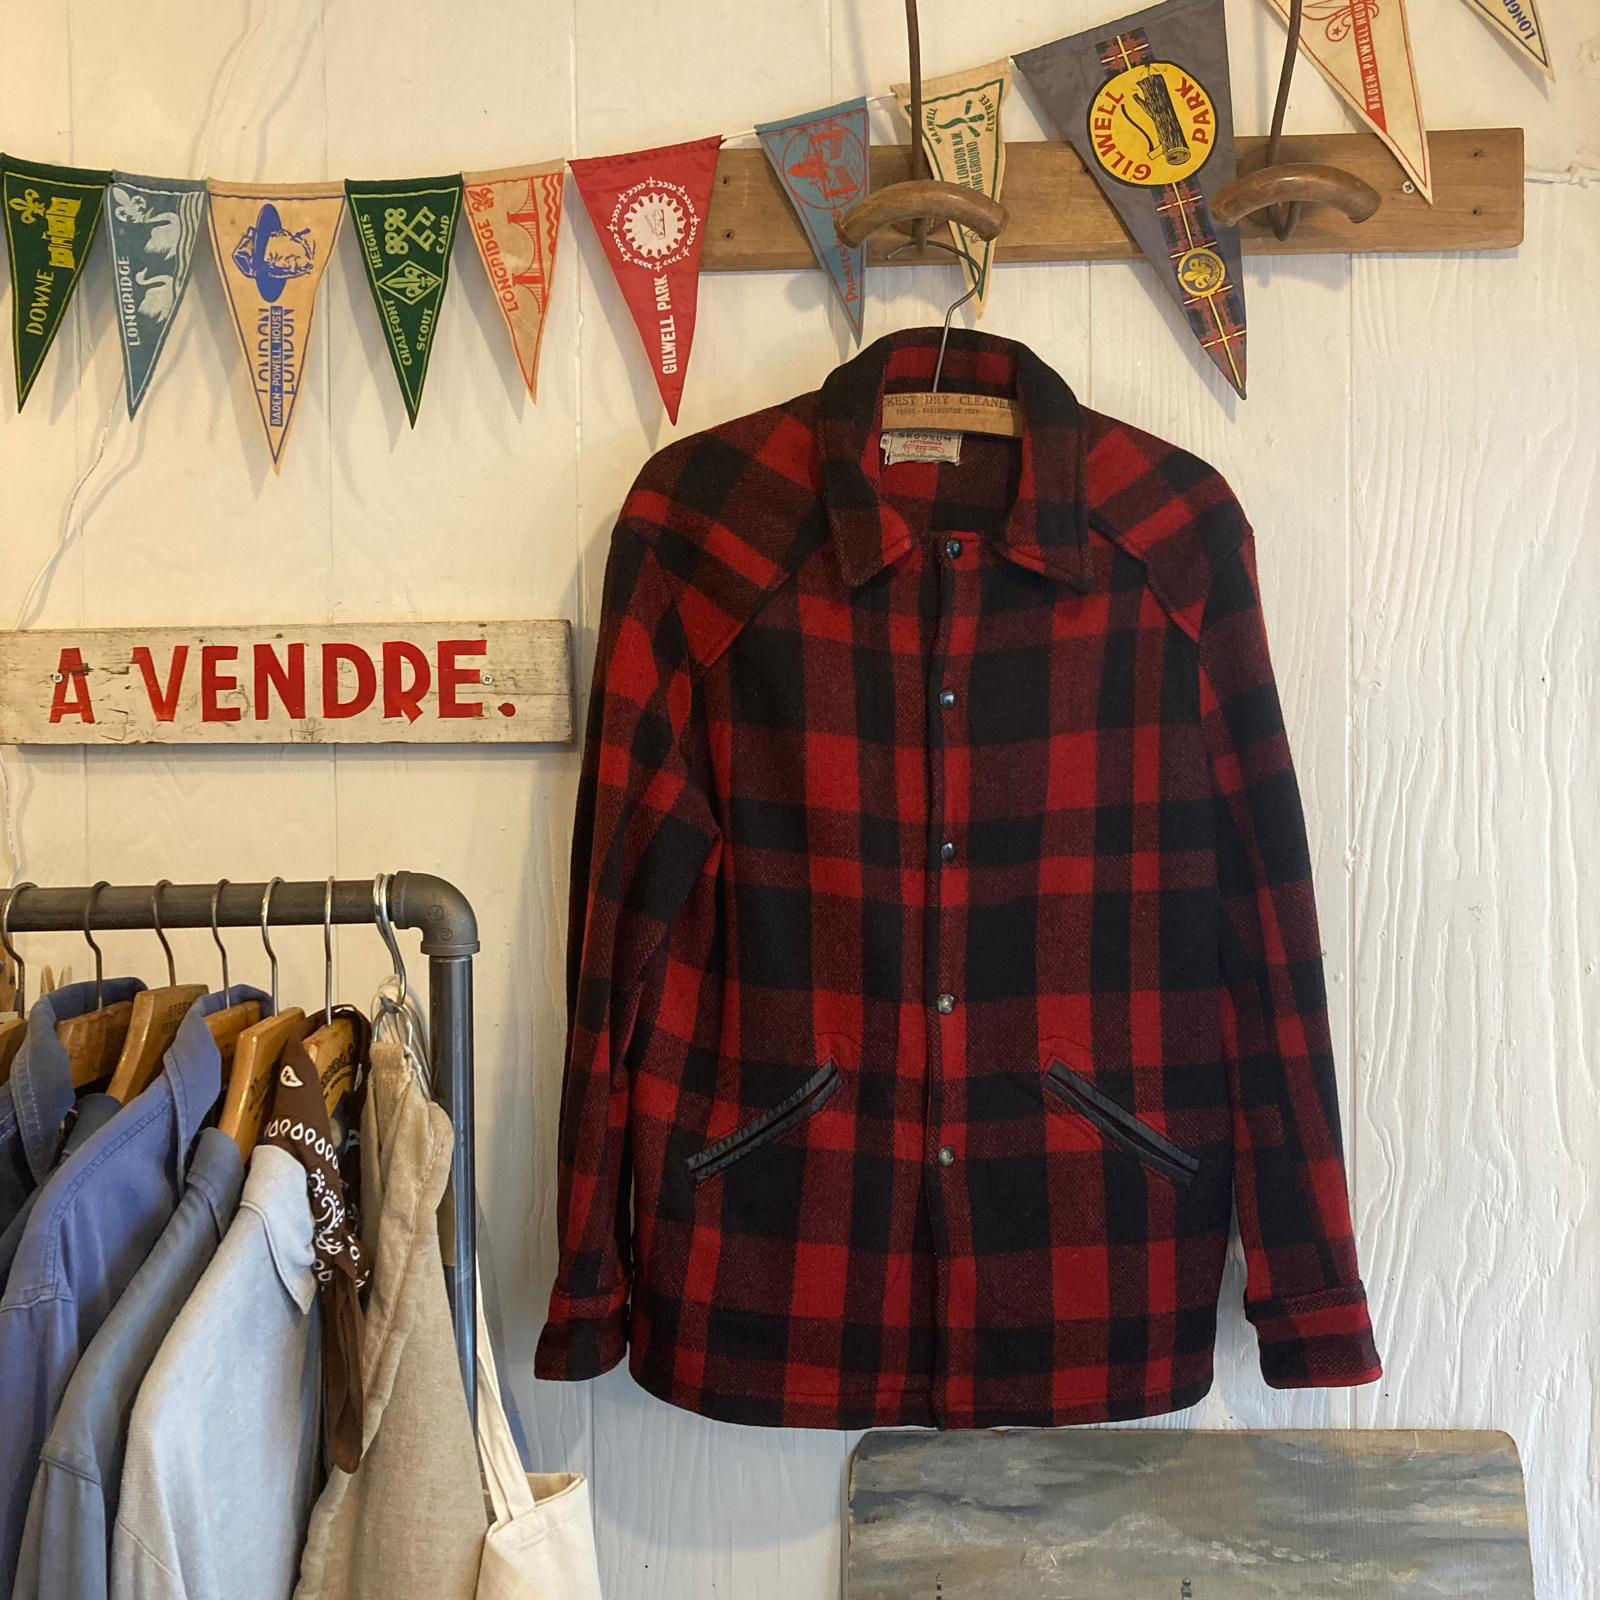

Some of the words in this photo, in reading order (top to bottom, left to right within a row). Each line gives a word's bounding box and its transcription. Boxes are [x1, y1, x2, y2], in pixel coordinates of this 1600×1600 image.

[1358, 26, 1380, 110] BADEN-POWELL
[926, 107, 943, 145] WAXWELL
[978, 94, 995, 132] ELSTREE
[1090, 91, 1152, 182] GILWELL
[1177, 76, 1211, 146] PARK
[954, 147, 968, 180] LONDON
[966, 141, 982, 173] GROUND
[359, 214, 383, 269] HEIGHTS
[477, 219, 519, 314] LONGRIDGE
[25, 268, 55, 336] DOWNE
[117, 255, 142, 347] LONGRIDGE
[416, 309, 435, 352] SCOUT
[436, 214, 450, 255] CAMP
[654, 274, 670, 310] PARK
[257, 308, 296, 395] LONDON
[271, 307, 283, 344] HOUSE
[385, 299, 413, 366] CHALFONT
[659, 317, 677, 373] GILWELL
[925, 394, 951, 406] DRY
[48, 648, 96, 724] A
[131, 639, 517, 725] VENDRE.
